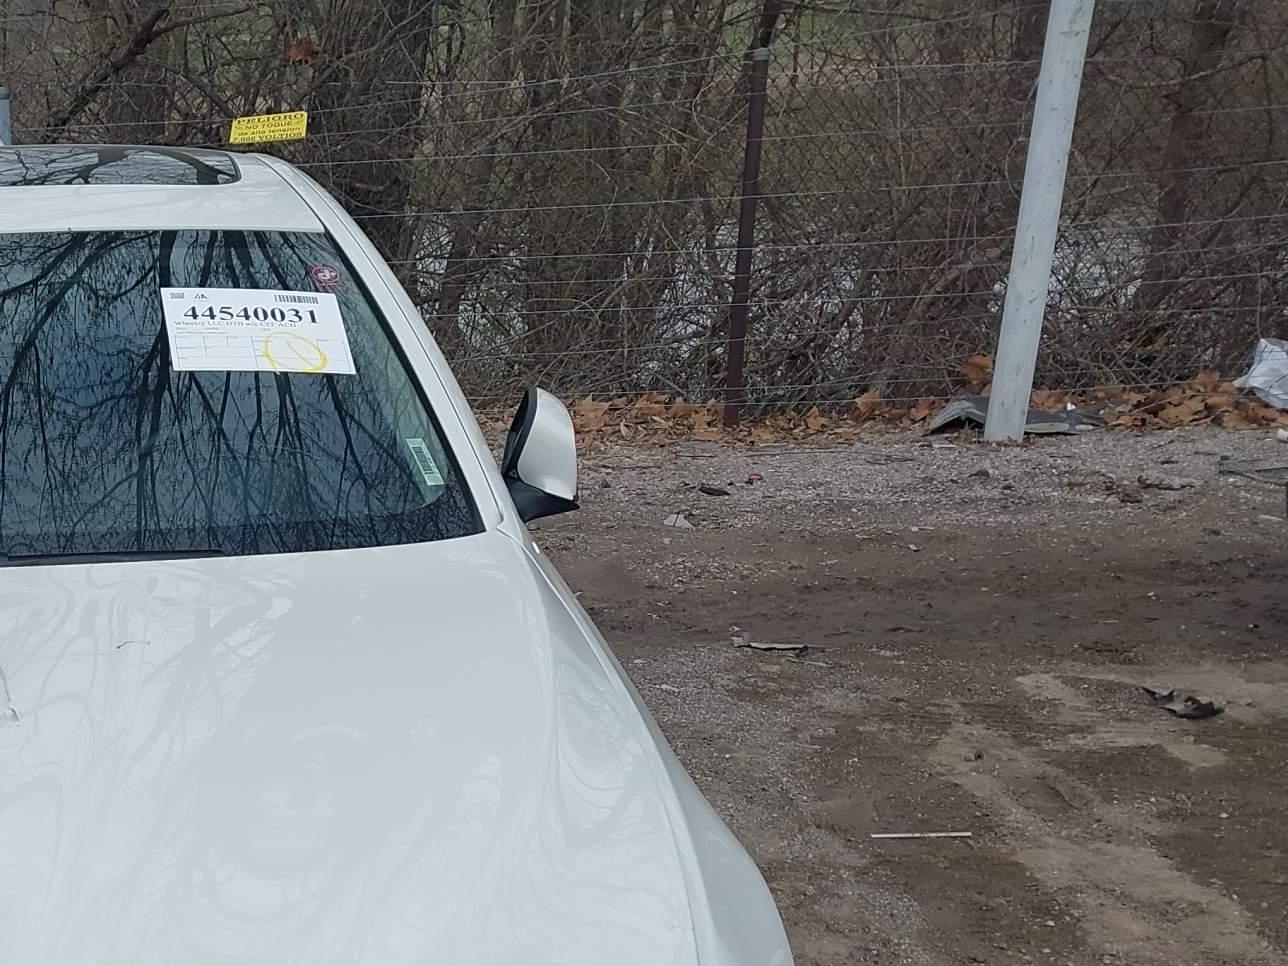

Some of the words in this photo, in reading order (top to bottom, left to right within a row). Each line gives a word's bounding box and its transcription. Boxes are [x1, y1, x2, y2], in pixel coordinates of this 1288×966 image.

[237, 113, 304, 125] PELIGRO
[261, 121, 293, 129] TOQUE
[258, 132, 303, 140] VOLTIOS
[184, 305, 321, 324] 44540031
